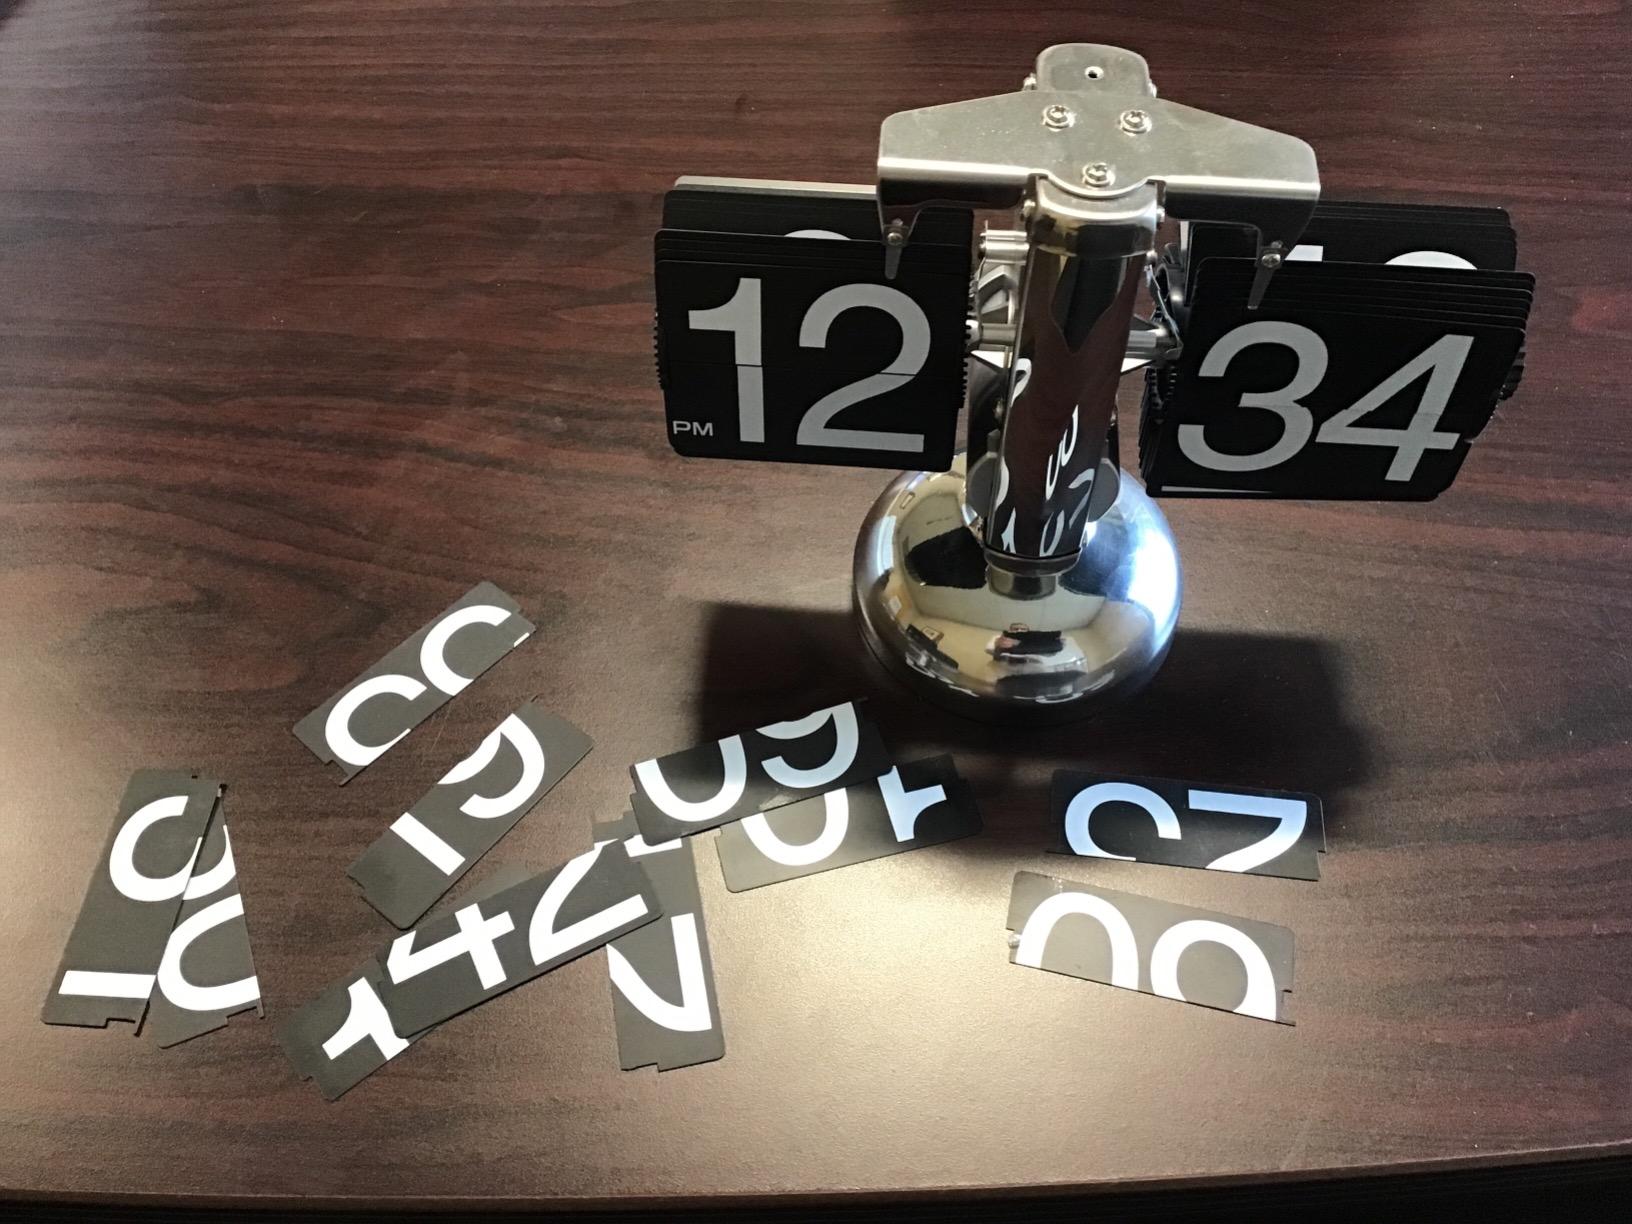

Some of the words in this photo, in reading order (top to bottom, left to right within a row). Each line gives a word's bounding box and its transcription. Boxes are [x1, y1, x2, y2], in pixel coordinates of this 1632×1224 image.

[672, 420, 714, 436] PM
[687, 276, 931, 453] 12
[1177, 320, 1475, 482] 34
